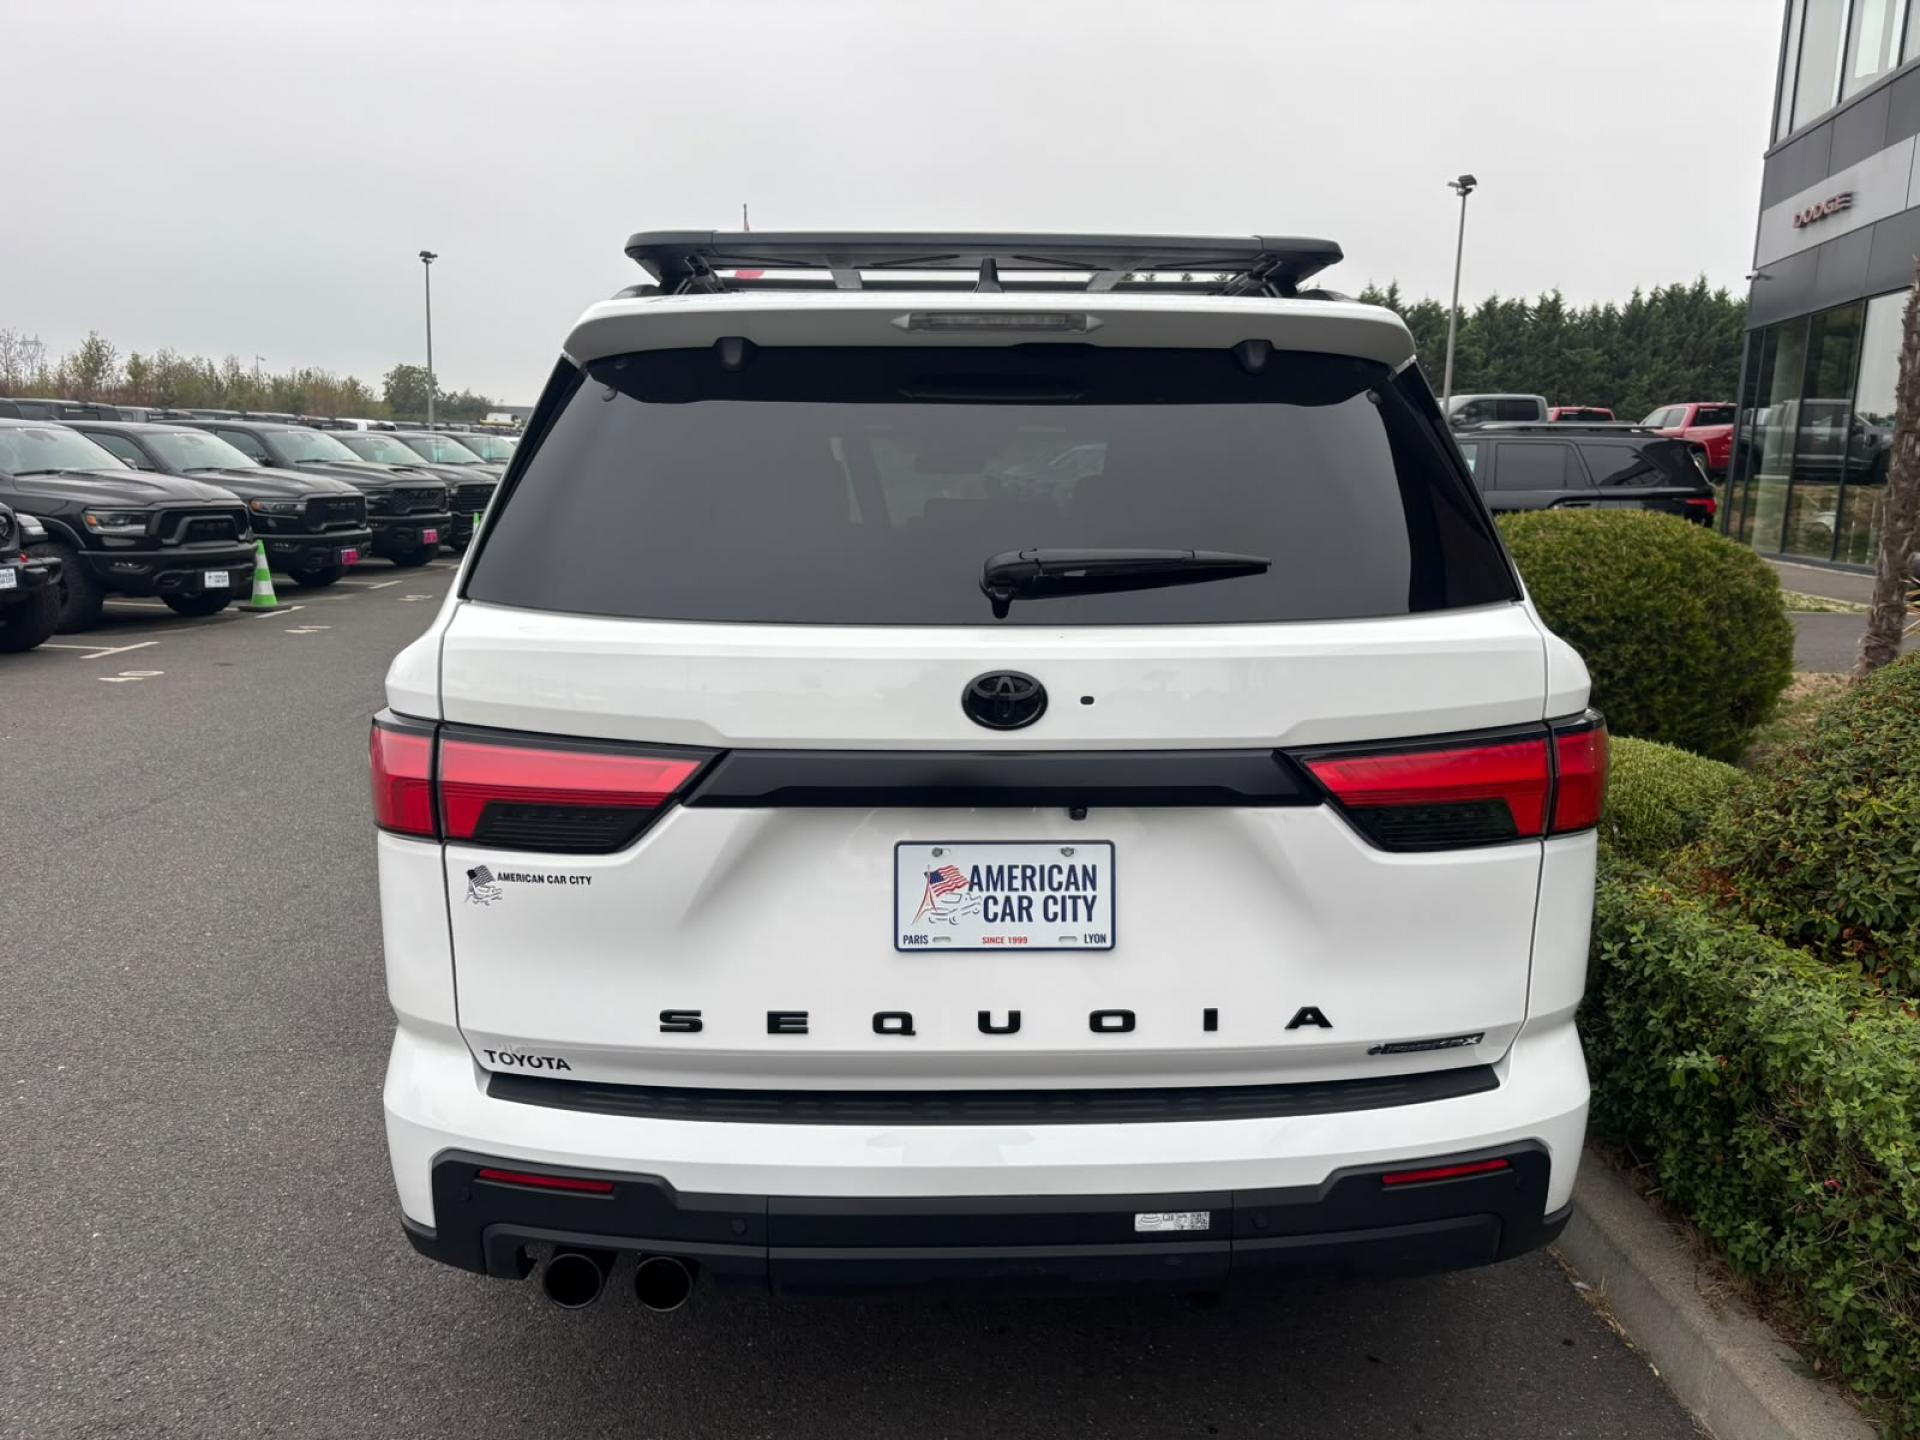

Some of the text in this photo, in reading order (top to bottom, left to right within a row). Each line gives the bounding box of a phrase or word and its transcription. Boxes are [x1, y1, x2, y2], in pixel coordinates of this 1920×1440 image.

[1792, 191, 1854, 229] DODGE
[497, 872, 592, 885] AMERICAN CAR CITY
[968, 864, 1098, 892] AMERICAN
[983, 895, 1098, 923] CAR CITY
[903, 934, 929, 945] PARIS
[982, 936, 1005, 945] SINCE
[1084, 933, 1107, 945] LYON
[659, 1007, 1334, 1036] SEQUOIA
[483, 1049, 572, 1071] TOYOTA
